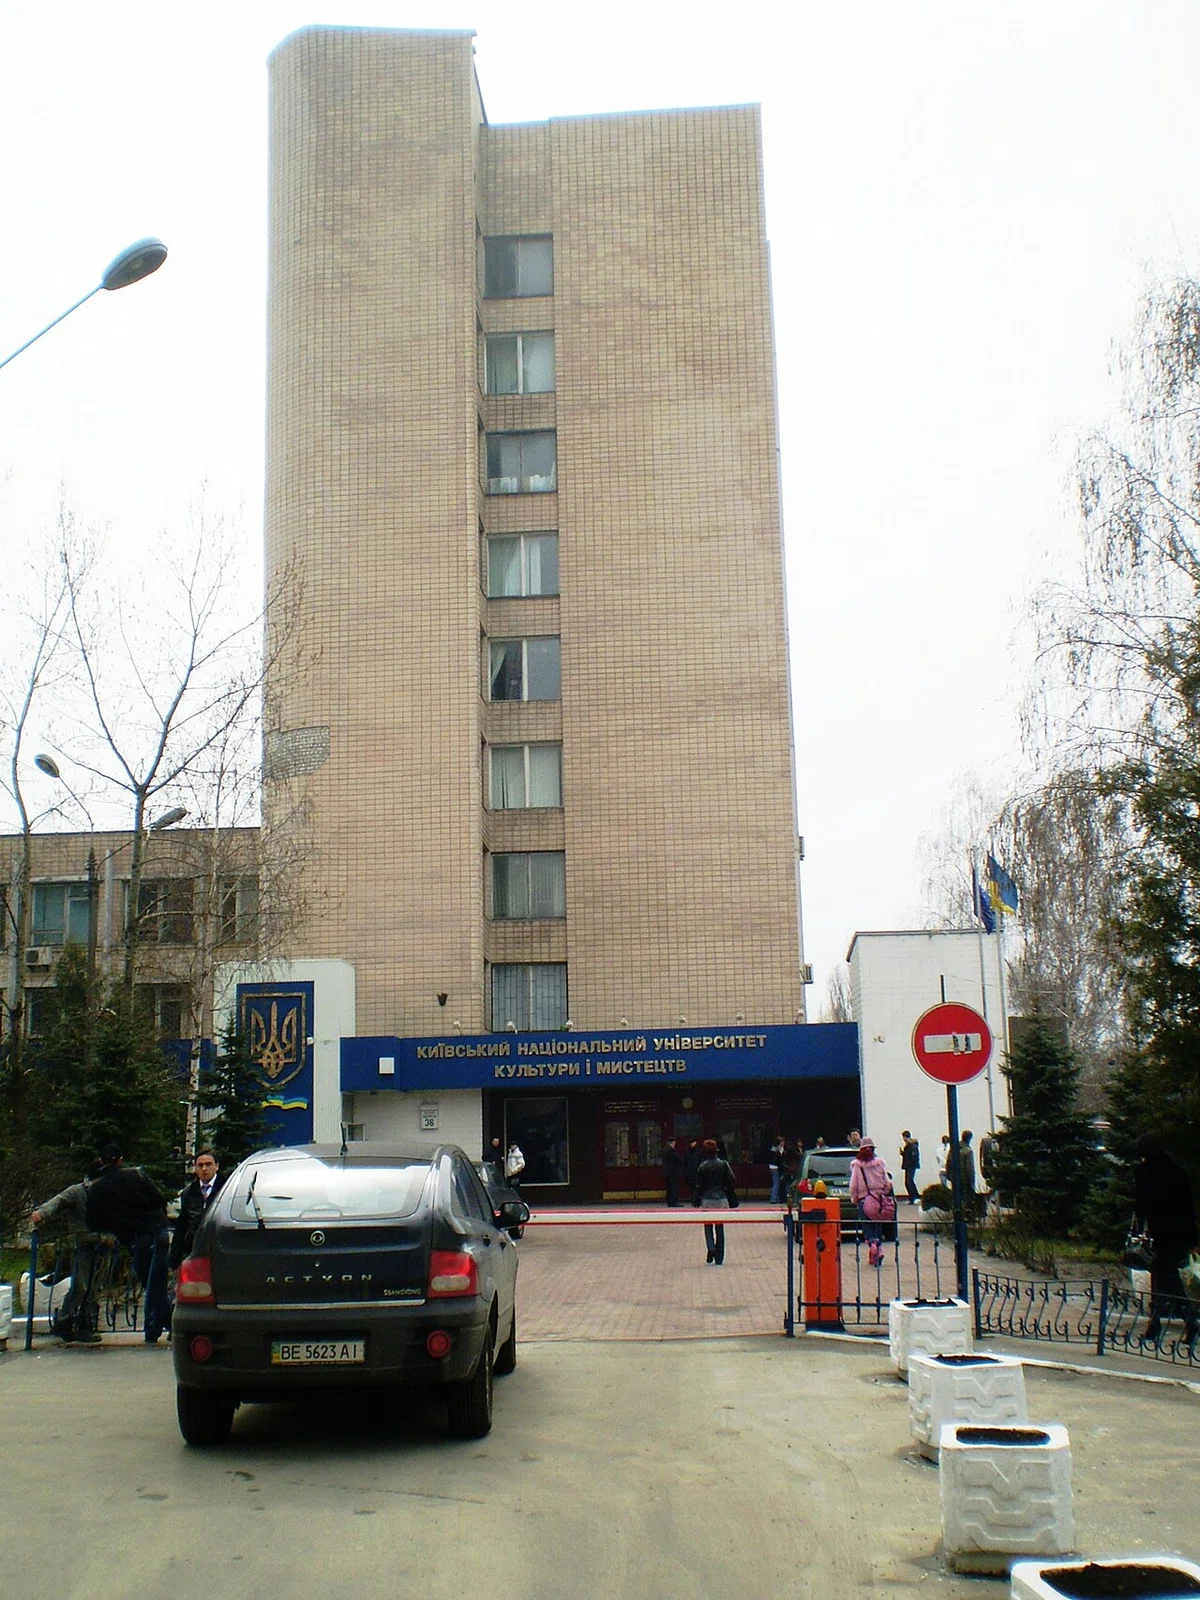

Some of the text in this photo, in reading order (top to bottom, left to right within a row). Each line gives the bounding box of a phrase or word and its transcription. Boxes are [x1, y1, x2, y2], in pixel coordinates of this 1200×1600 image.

[416, 1041, 511, 1059] КИЇВСЬКИЙ
[494, 1062, 580, 1078] КУЛЬТУРИ
[596, 1059, 687, 1075] МИСТЕЦТВ
[424, 1118, 435, 1127] 36
[266, 1274, 373, 1283] ACTYON
[281, 1344, 357, 1360] BE 5623 AI
